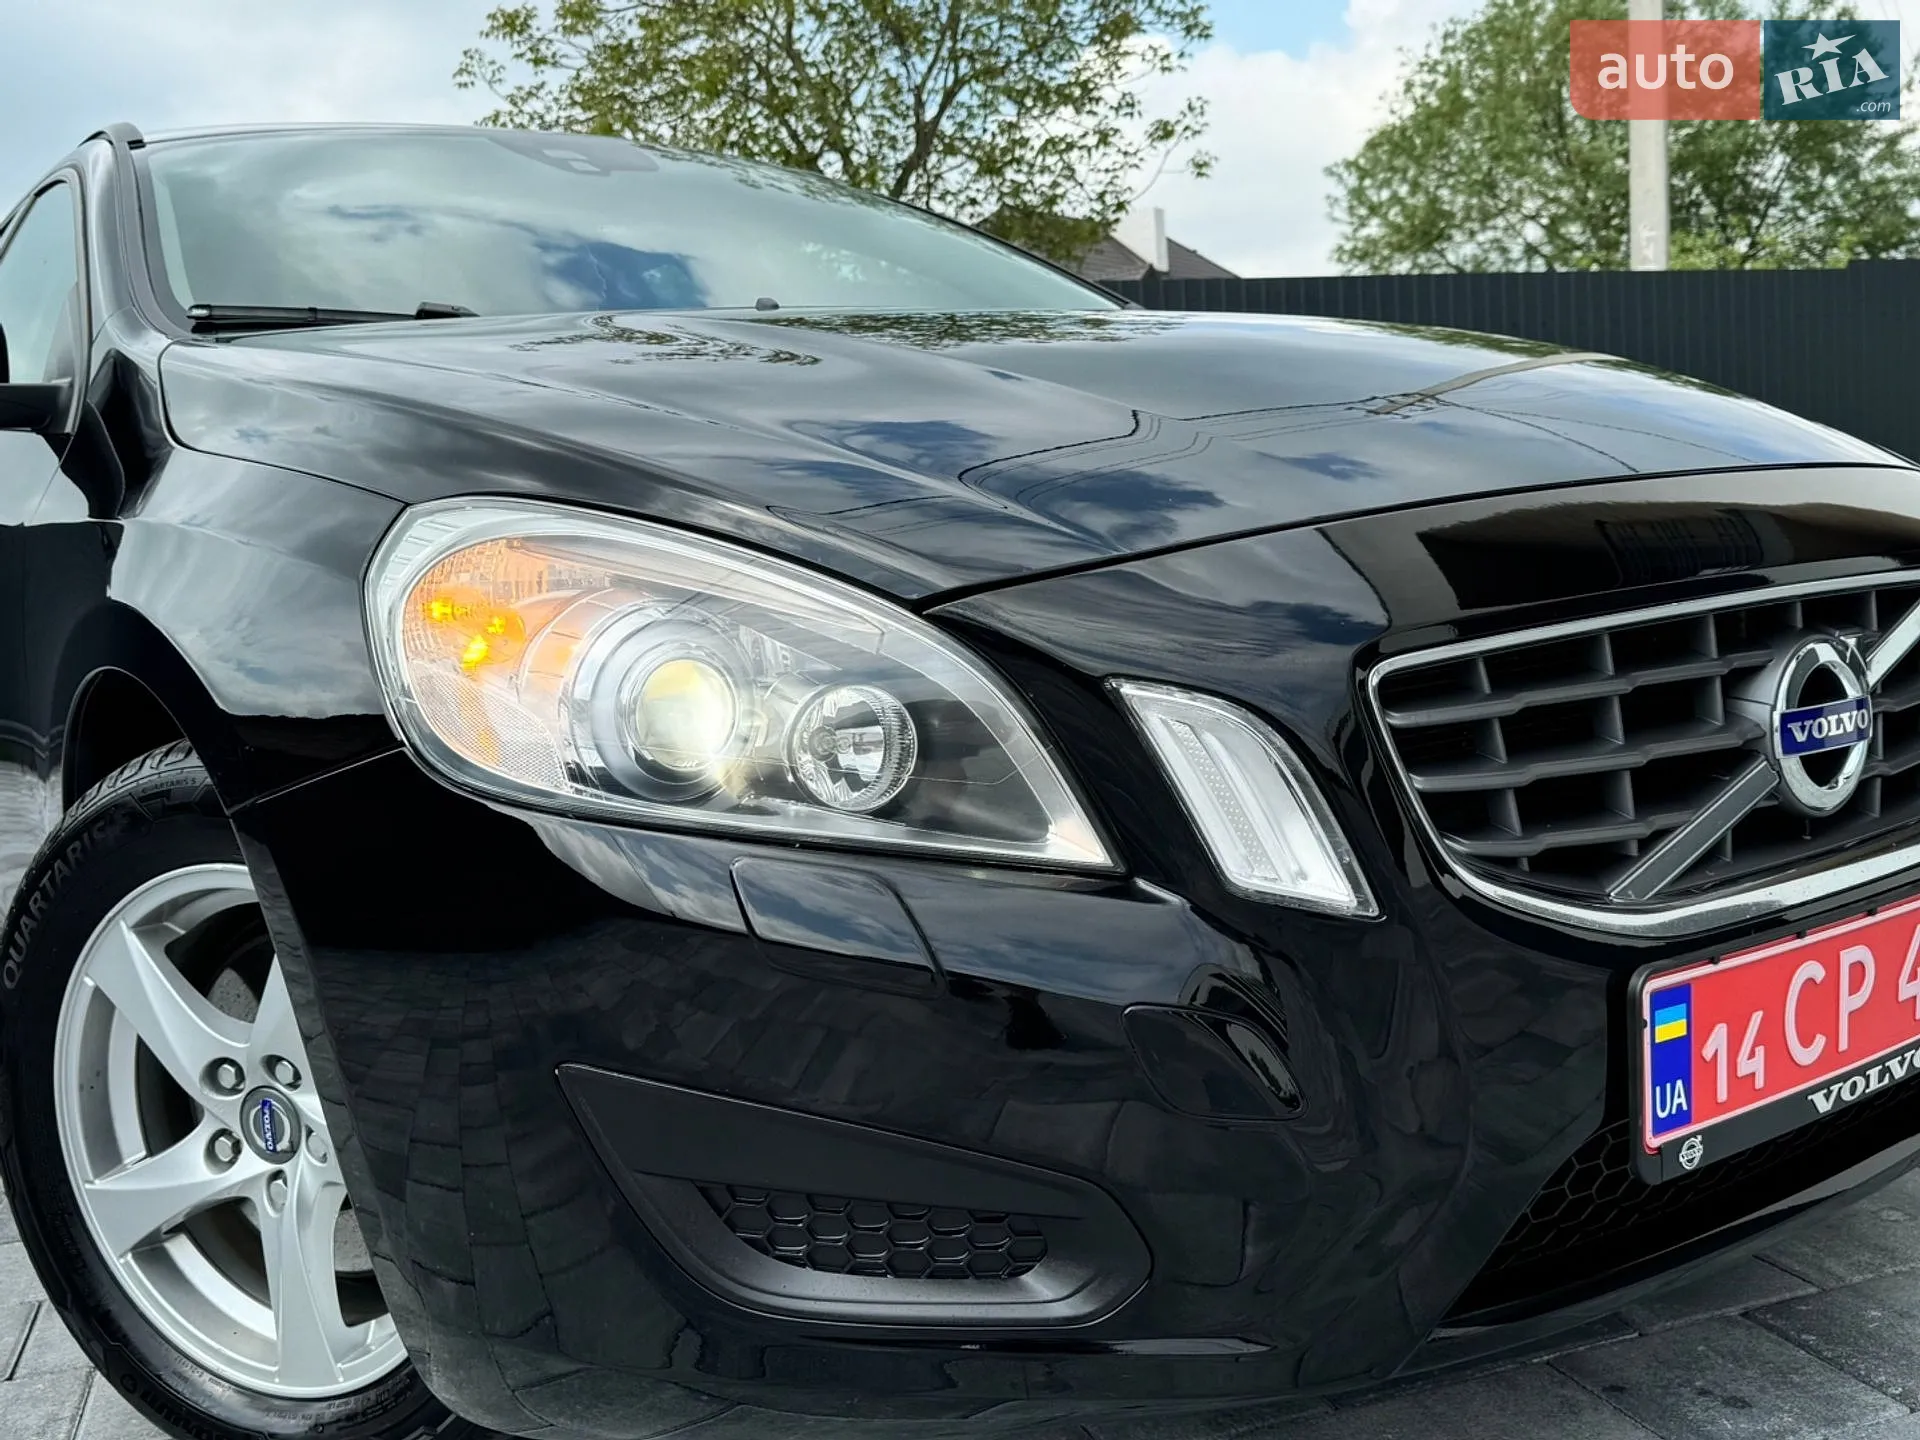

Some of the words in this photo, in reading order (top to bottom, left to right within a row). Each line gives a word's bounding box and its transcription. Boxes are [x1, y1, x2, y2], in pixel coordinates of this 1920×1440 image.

[1787, 709, 1868, 743] VOLVO
[1701, 1010, 1765, 1104] 14
[1784, 945, 1876, 1067] CP
[1655, 1079, 1688, 1119] UA
